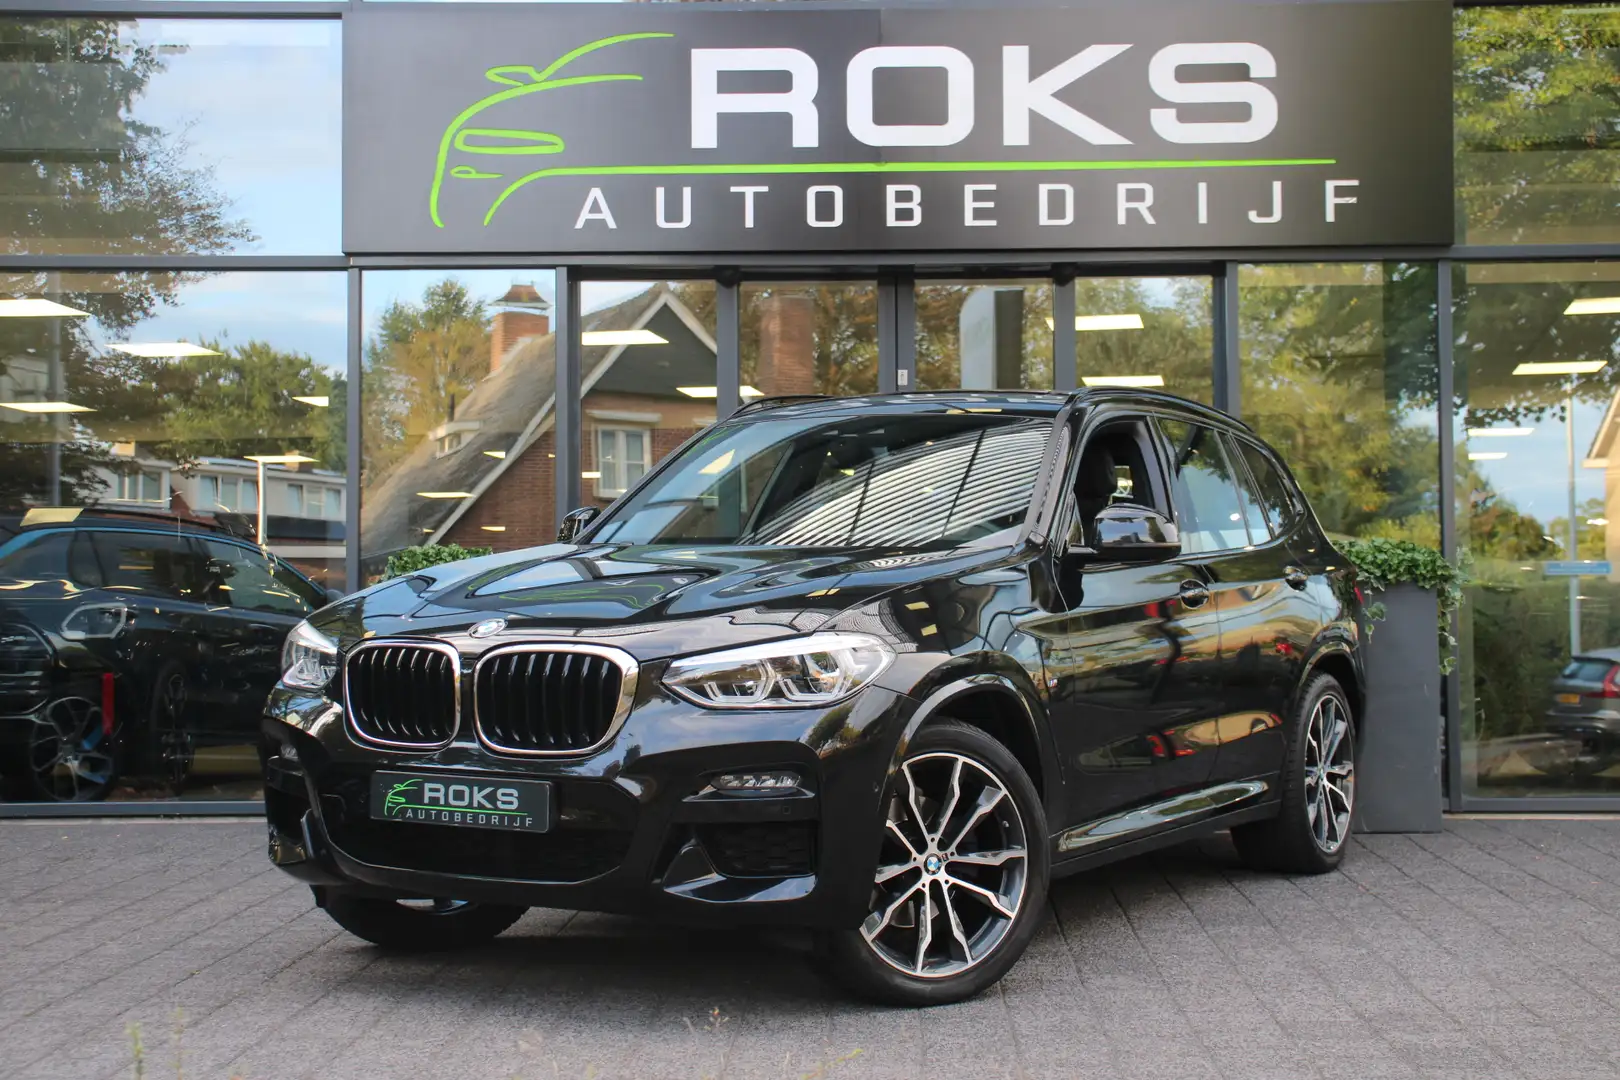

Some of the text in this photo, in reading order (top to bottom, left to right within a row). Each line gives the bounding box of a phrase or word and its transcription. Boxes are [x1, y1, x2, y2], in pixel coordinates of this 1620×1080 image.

[690, 42, 1278, 149] ROKS
[574, 180, 1359, 229] AUTOBEDRIJF
[423, 782, 519, 810] ROKS
[405, 808, 533, 827] AUTOBEDRIJF
